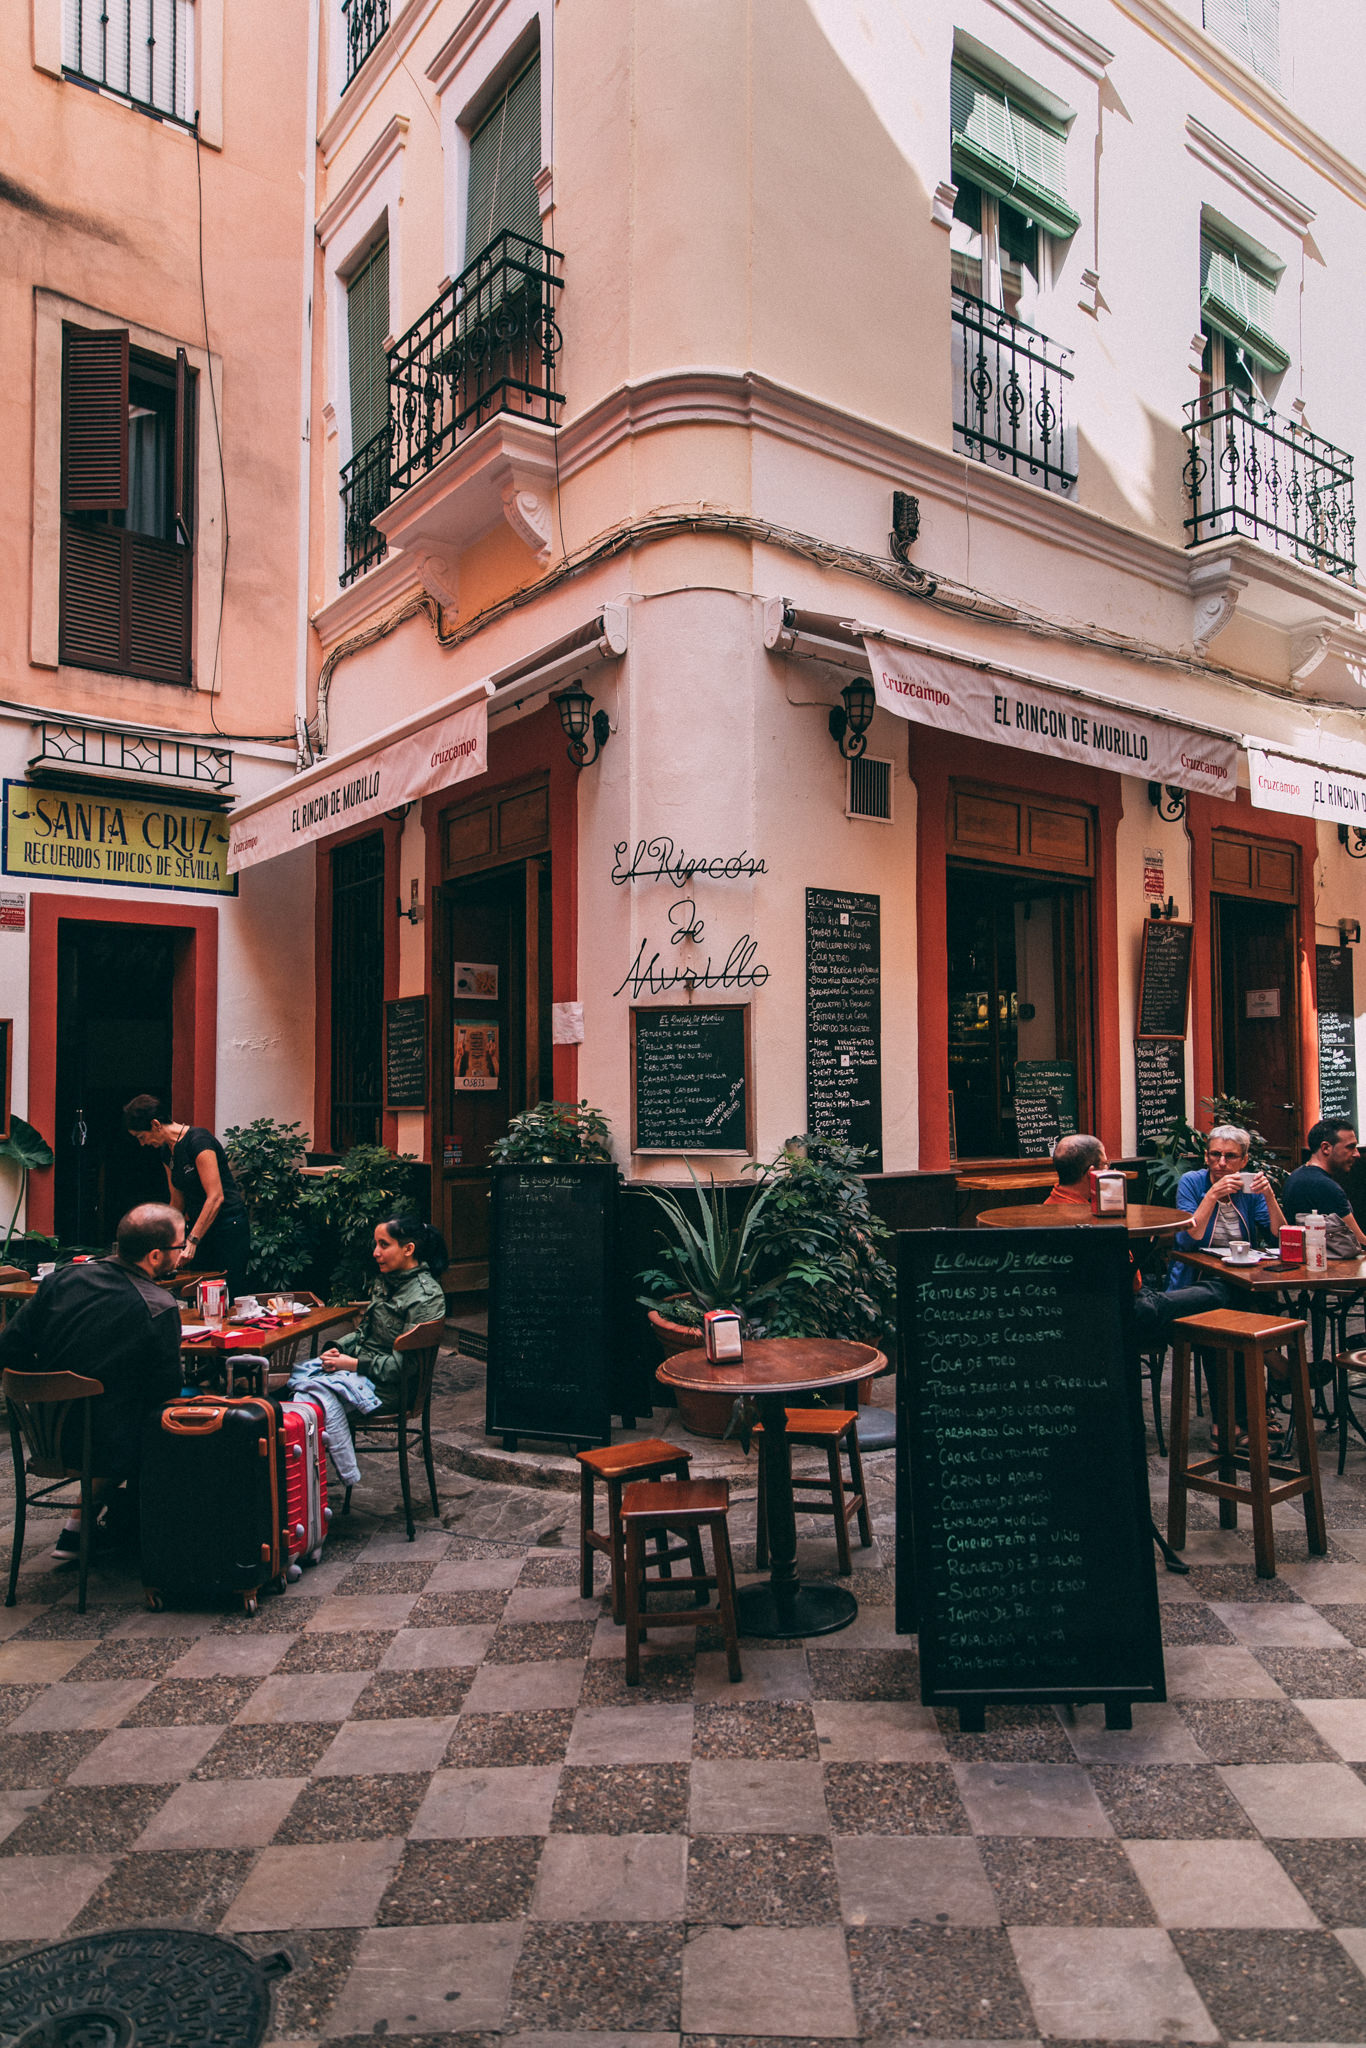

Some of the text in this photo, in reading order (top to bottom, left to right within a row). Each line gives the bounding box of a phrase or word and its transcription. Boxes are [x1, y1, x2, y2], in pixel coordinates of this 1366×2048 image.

[883, 672, 950, 705] Cruzcampo
[994, 696, 1148, 761] EL RINCON DE MURILLO
[431, 738, 476, 767] Cruzcampo
[1181, 752, 1228, 780] Cruzcampo
[1258, 776, 1300, 796] Cruzcampo
[1314, 781, 1324, 803] EL
[1328, 784, 1359, 810] RINCON
[292, 771, 380, 832] EL RINCON DE MURILLO
[34, 799, 213, 858] SANTA CRUZ
[233, 835, 258, 855] Cruzcampo
[24, 841, 220, 881] RECUERDOS TIPICOS DE SEVILLA
[612, 837, 768, 888] El Rincón
[613, 934, 771, 999] Murillo
[660, 1015, 669, 1024] EL
[935, 1252, 1074, 1273] EL RINCON DE MURILLO
[980, 1286, 998, 1301] DE
[1004, 1286, 1020, 1296] LA
[1025, 1284, 1056, 1296] CASA
[1020, 1306, 1033, 1316] SU
[927, 1331, 978, 1347] SURTIDO
[978, 1333, 999, 1347] DE
[931, 1353, 1016, 1375] COLA DE TORO
[1024, 1381, 1030, 1394] A
[1035, 1381, 1048, 1389] LA
[1002, 1424, 1023, 1435] CON
[939, 1448, 978, 1465] CARNE
[986, 1473, 1000, 1485] EN
